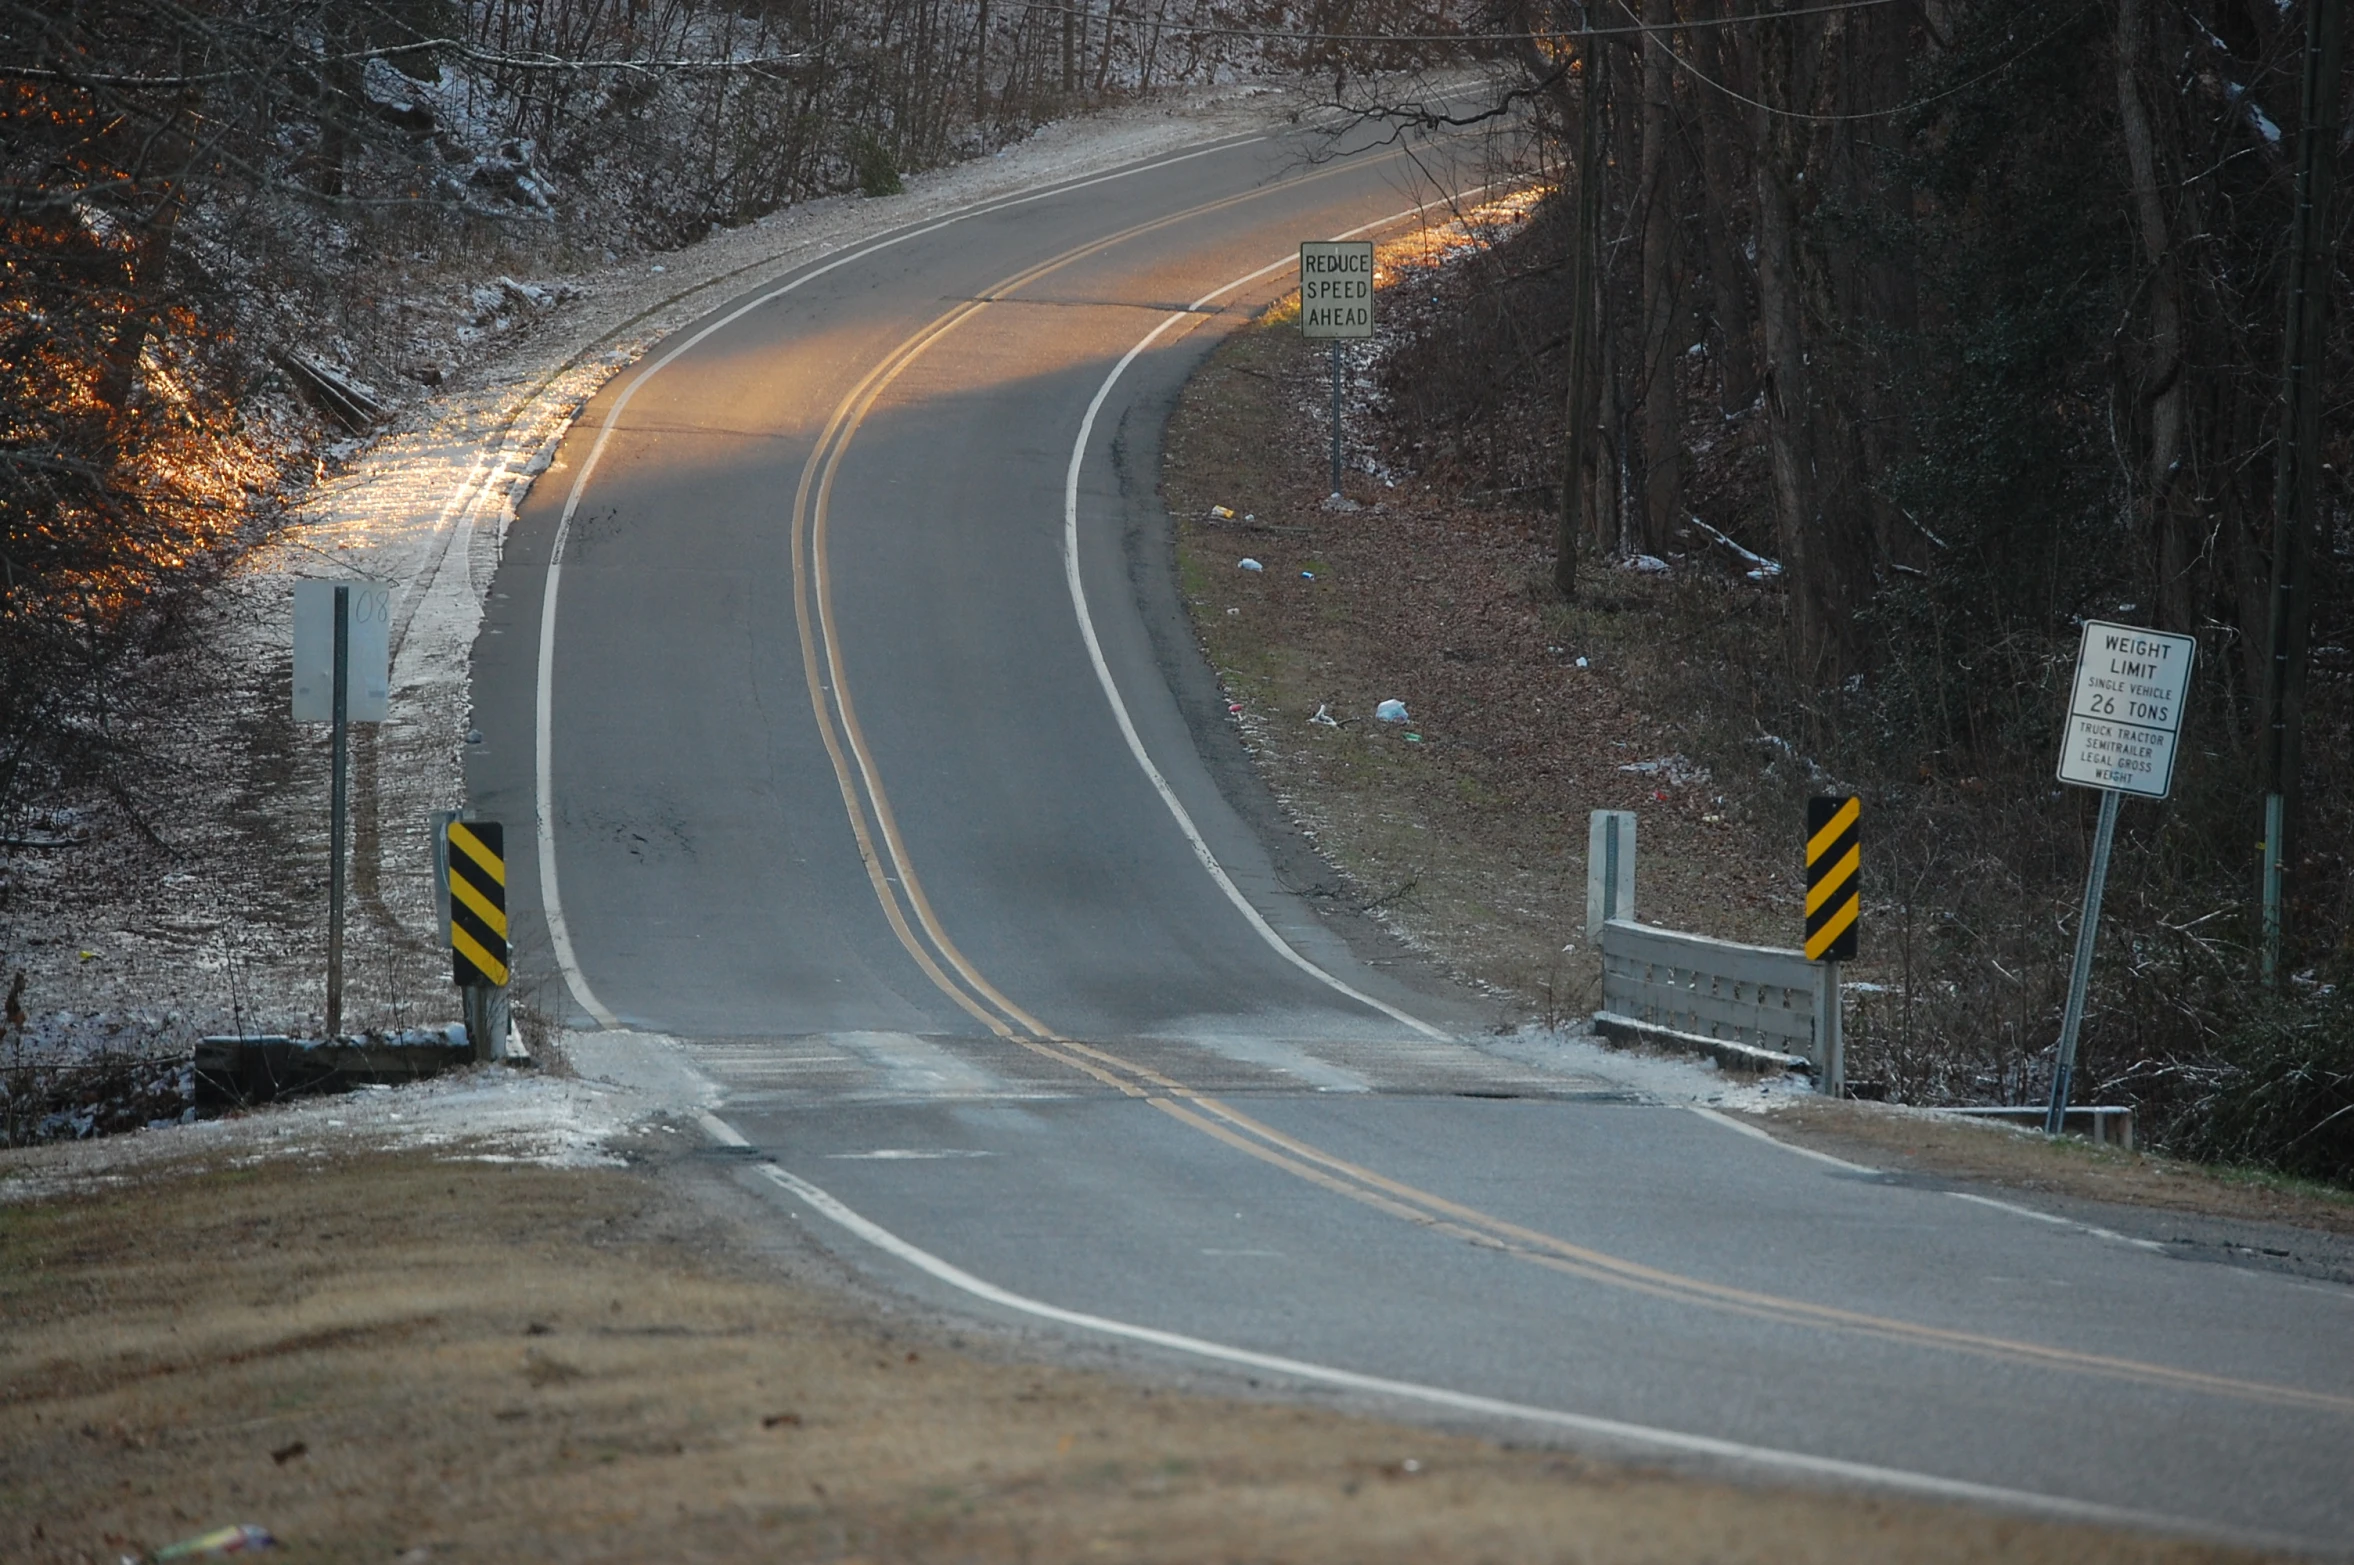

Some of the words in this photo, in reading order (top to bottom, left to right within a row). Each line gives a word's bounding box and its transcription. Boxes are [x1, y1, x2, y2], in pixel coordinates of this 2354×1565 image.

[1306, 254, 1369, 273] REDUCE
[1307, 280, 1367, 299] SPEED
[1308, 307, 1368, 326] AHEAD
[2105, 634, 2172, 660] WEIGHT
[2110, 658, 2158, 680] LIMIT
[2088, 676, 2125, 693] SINGLE
[2129, 683, 2173, 701] VEHICLE
[2090, 693, 2115, 715] 26
[2128, 701, 2169, 722] TONS
[2080, 721, 2112, 737] TRUCK
[2117, 728, 2164, 747] TRACTOR
[2085, 737, 2153, 759] SEMITRAILER
[2080, 751, 2113, 767] LEGAL
[2117, 757, 2152, 773] GROSS
[2095, 768, 2133, 785] WEIGHT
